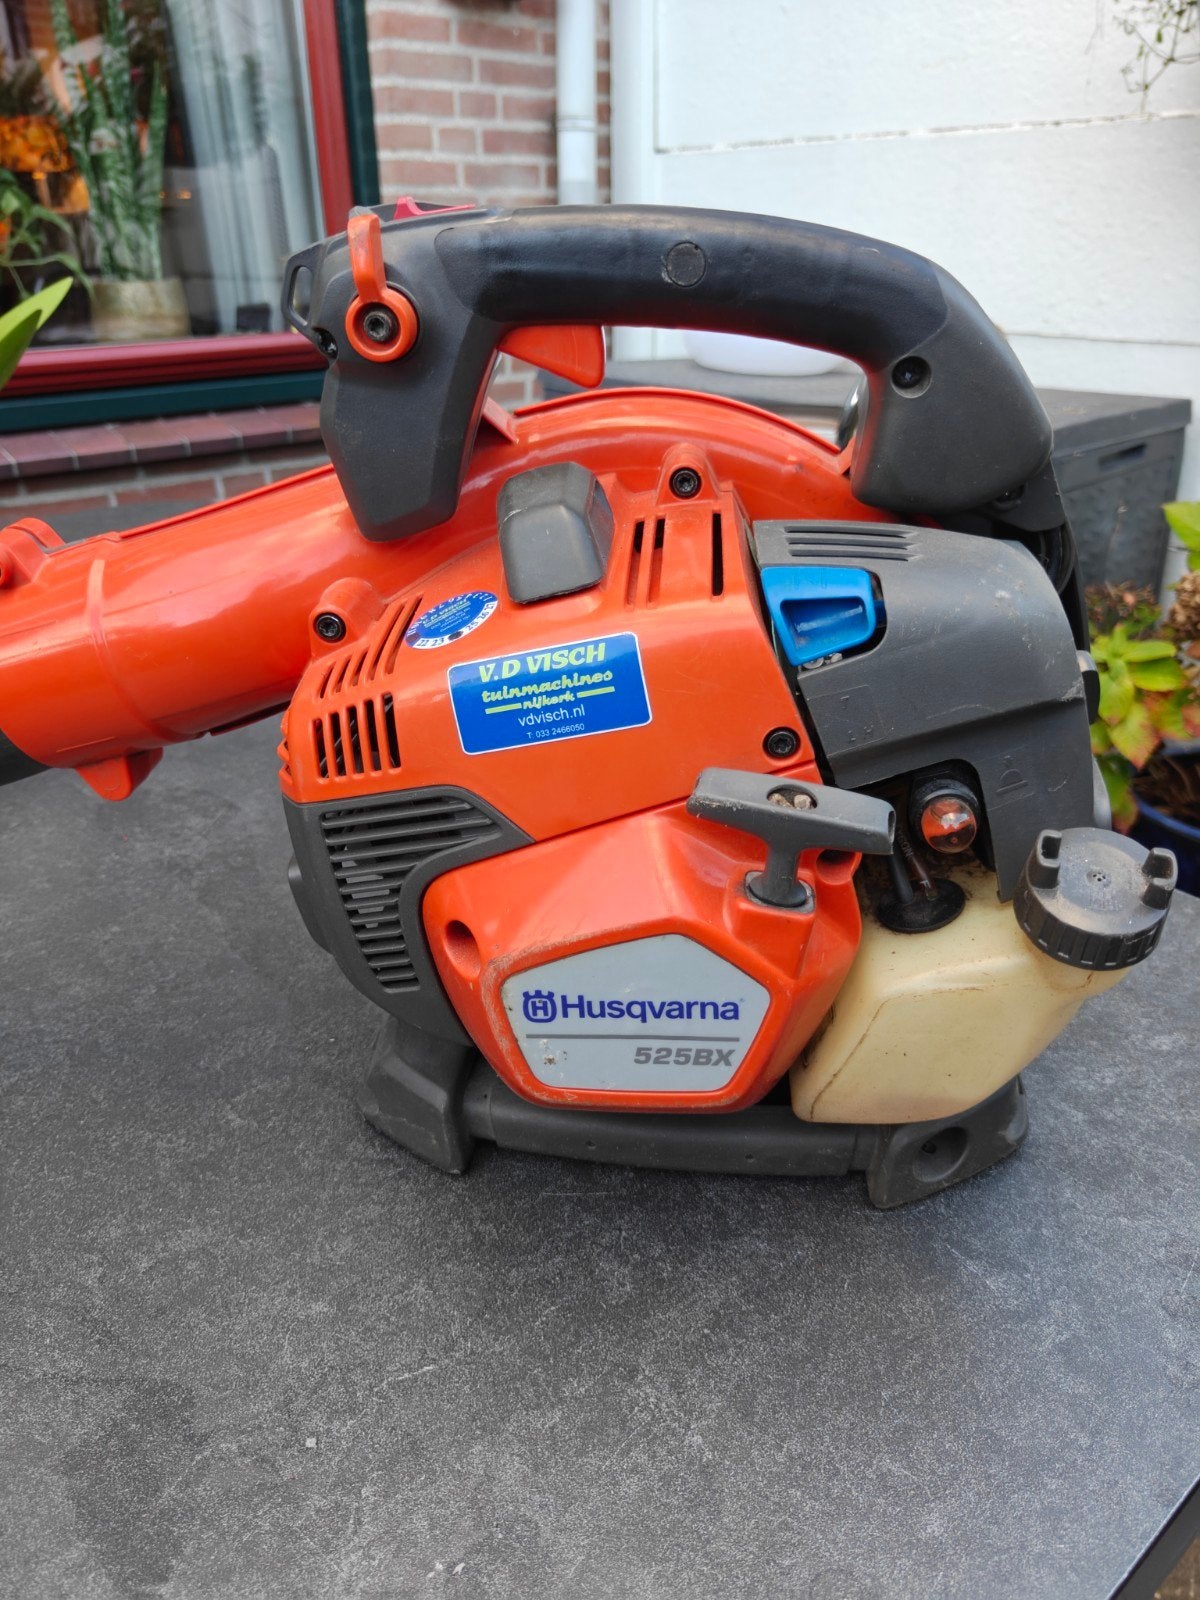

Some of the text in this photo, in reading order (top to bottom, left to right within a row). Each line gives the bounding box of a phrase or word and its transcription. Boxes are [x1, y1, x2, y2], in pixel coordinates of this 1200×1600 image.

[478, 642, 606, 683] V.D VISCH
[481, 670, 613, 703] tuinmachines
[522, 690, 575, 710] nijkerk
[518, 703, 586, 727] vdvisch.nl
[535, 729, 550, 738] 033
[551, 723, 585, 736] 2466050
[560, 994, 740, 1024] Husqvarna
[633, 1046, 736, 1067] 525BX
